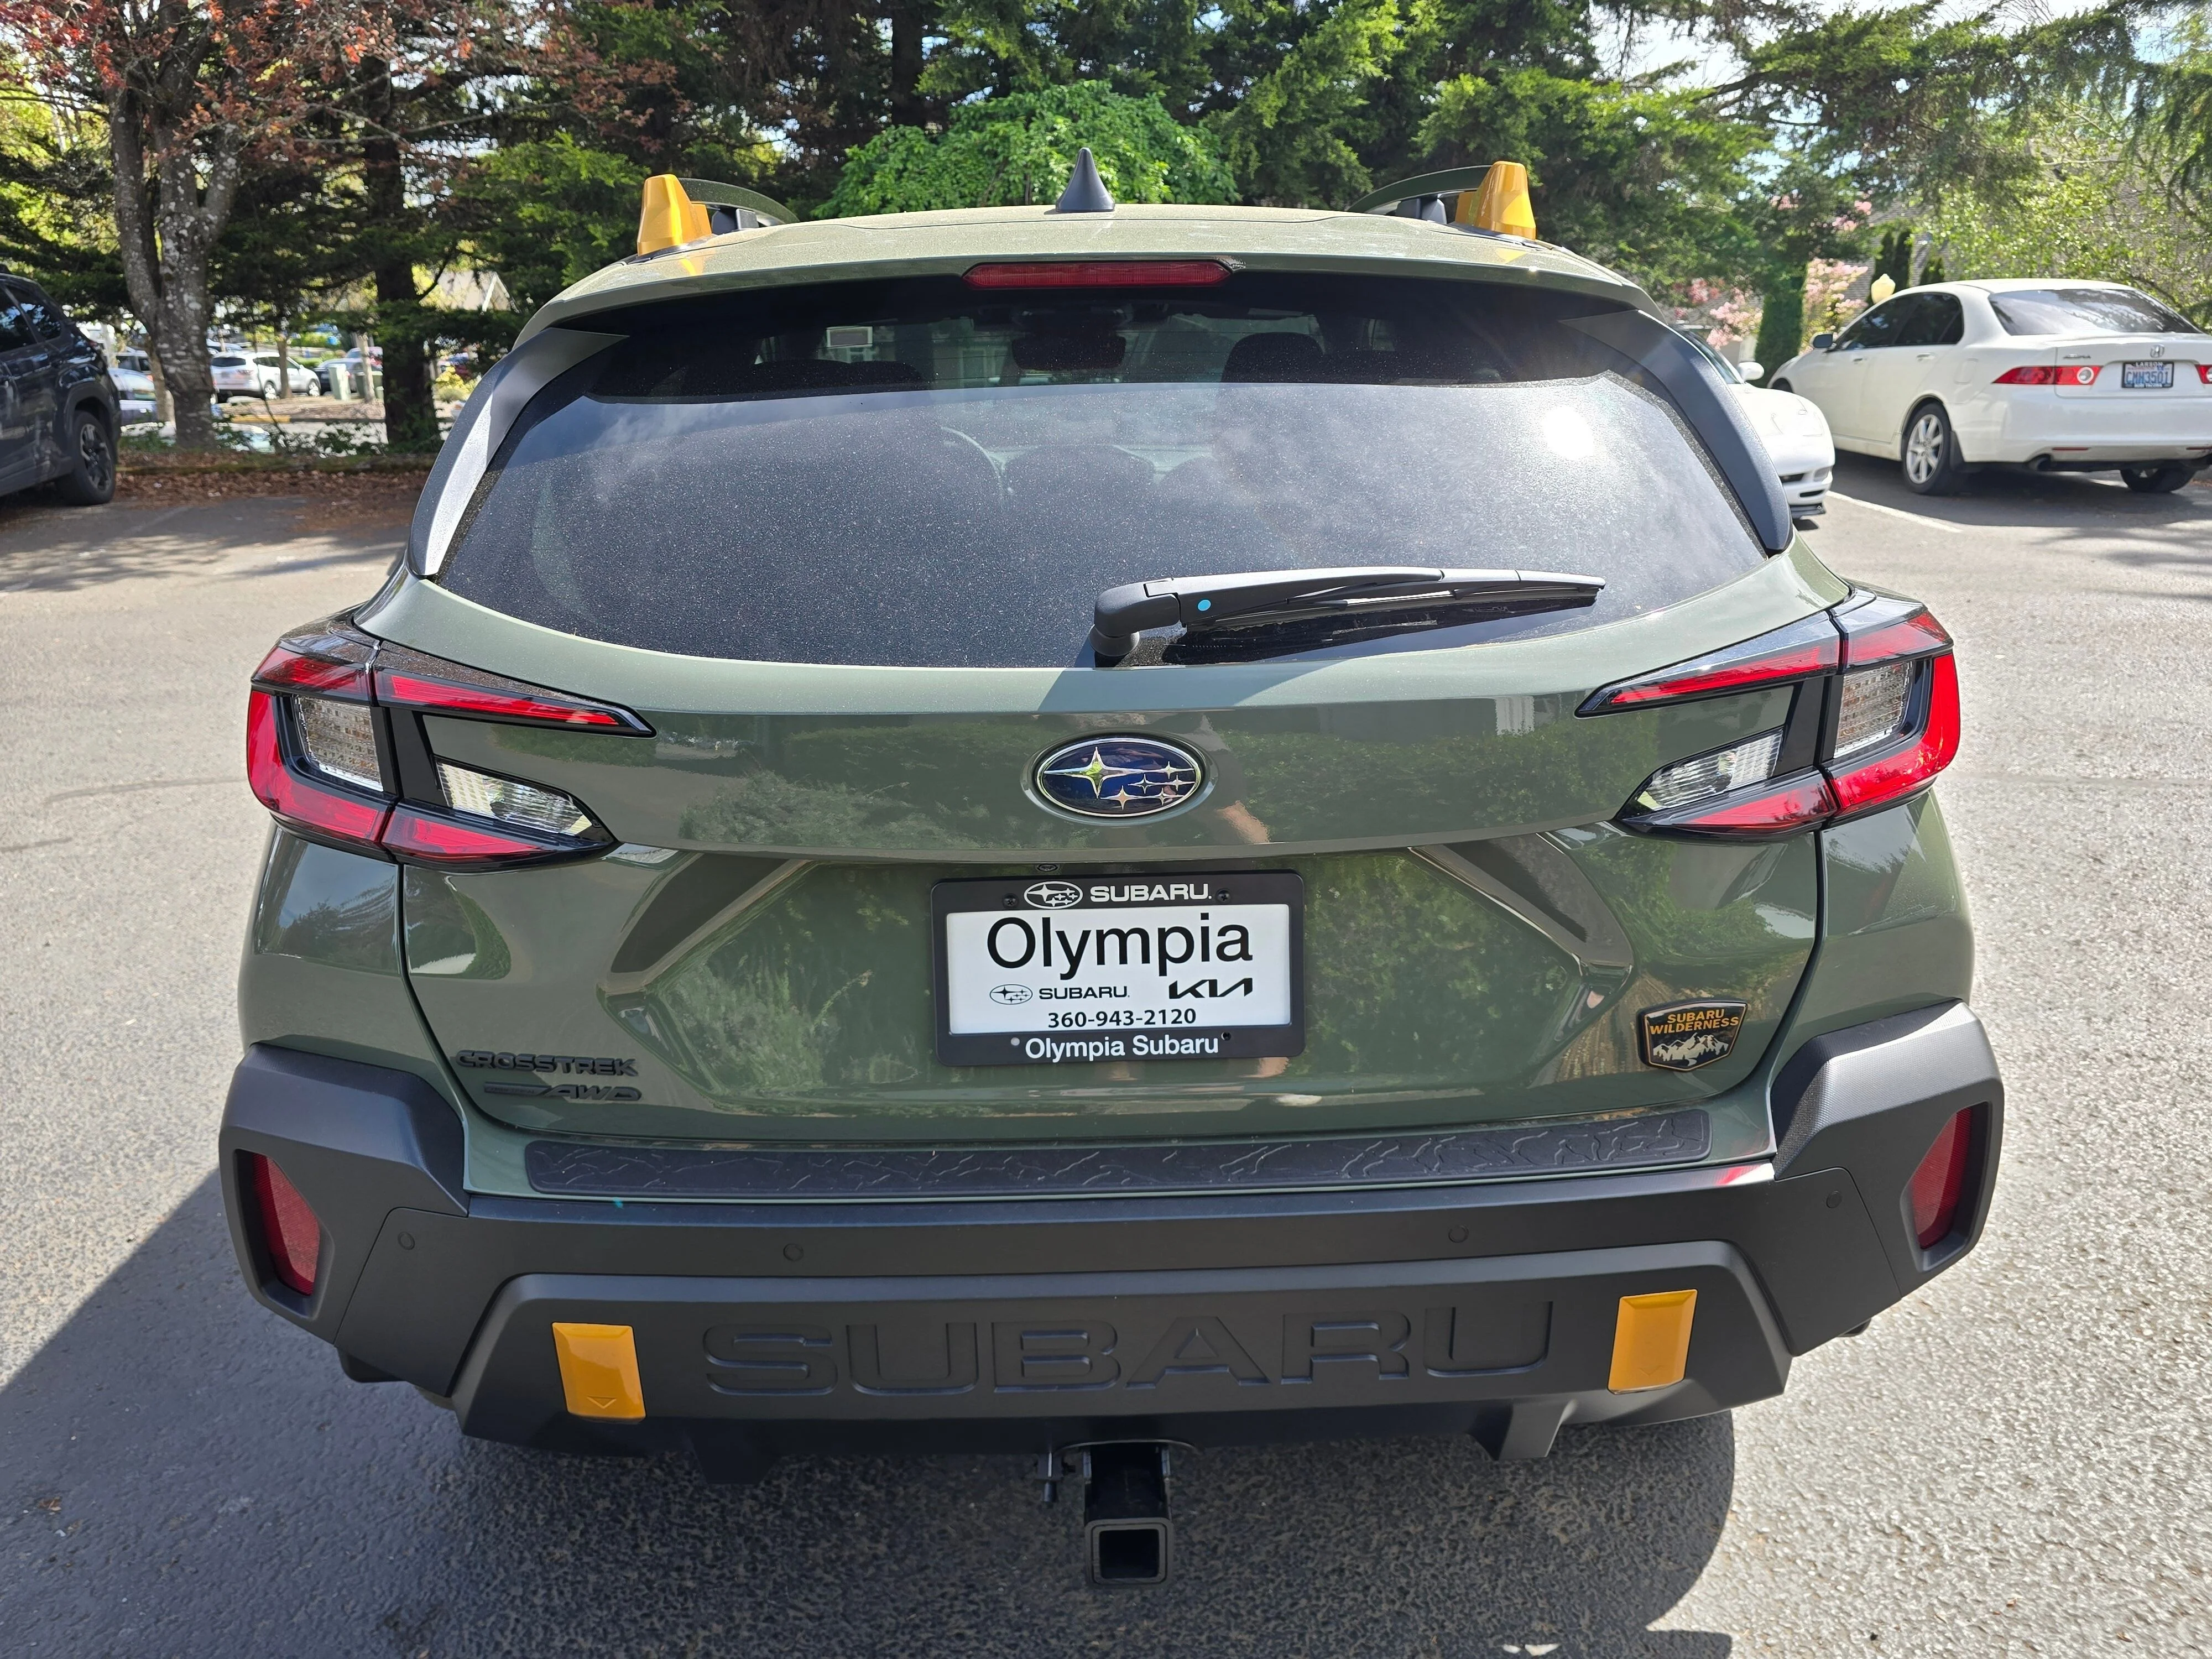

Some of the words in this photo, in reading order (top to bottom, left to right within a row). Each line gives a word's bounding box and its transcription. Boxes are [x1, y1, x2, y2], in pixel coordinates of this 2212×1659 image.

[987, 912, 1253, 980] Olympia
[1047, 1008, 1197, 1029] 360-943-2120
[1650, 1016, 1739, 1035] WILDERNESS
[1667, 1009, 1725, 1024] SUBARU
[1025, 1037, 1125, 1063] Olympia
[1132, 1035, 1219, 1056] Subaru
[456, 1050, 639, 1076] CROSSTREK
[545, 1083, 642, 1102] AWD
[702, 1300, 1555, 1395] SUBARU
